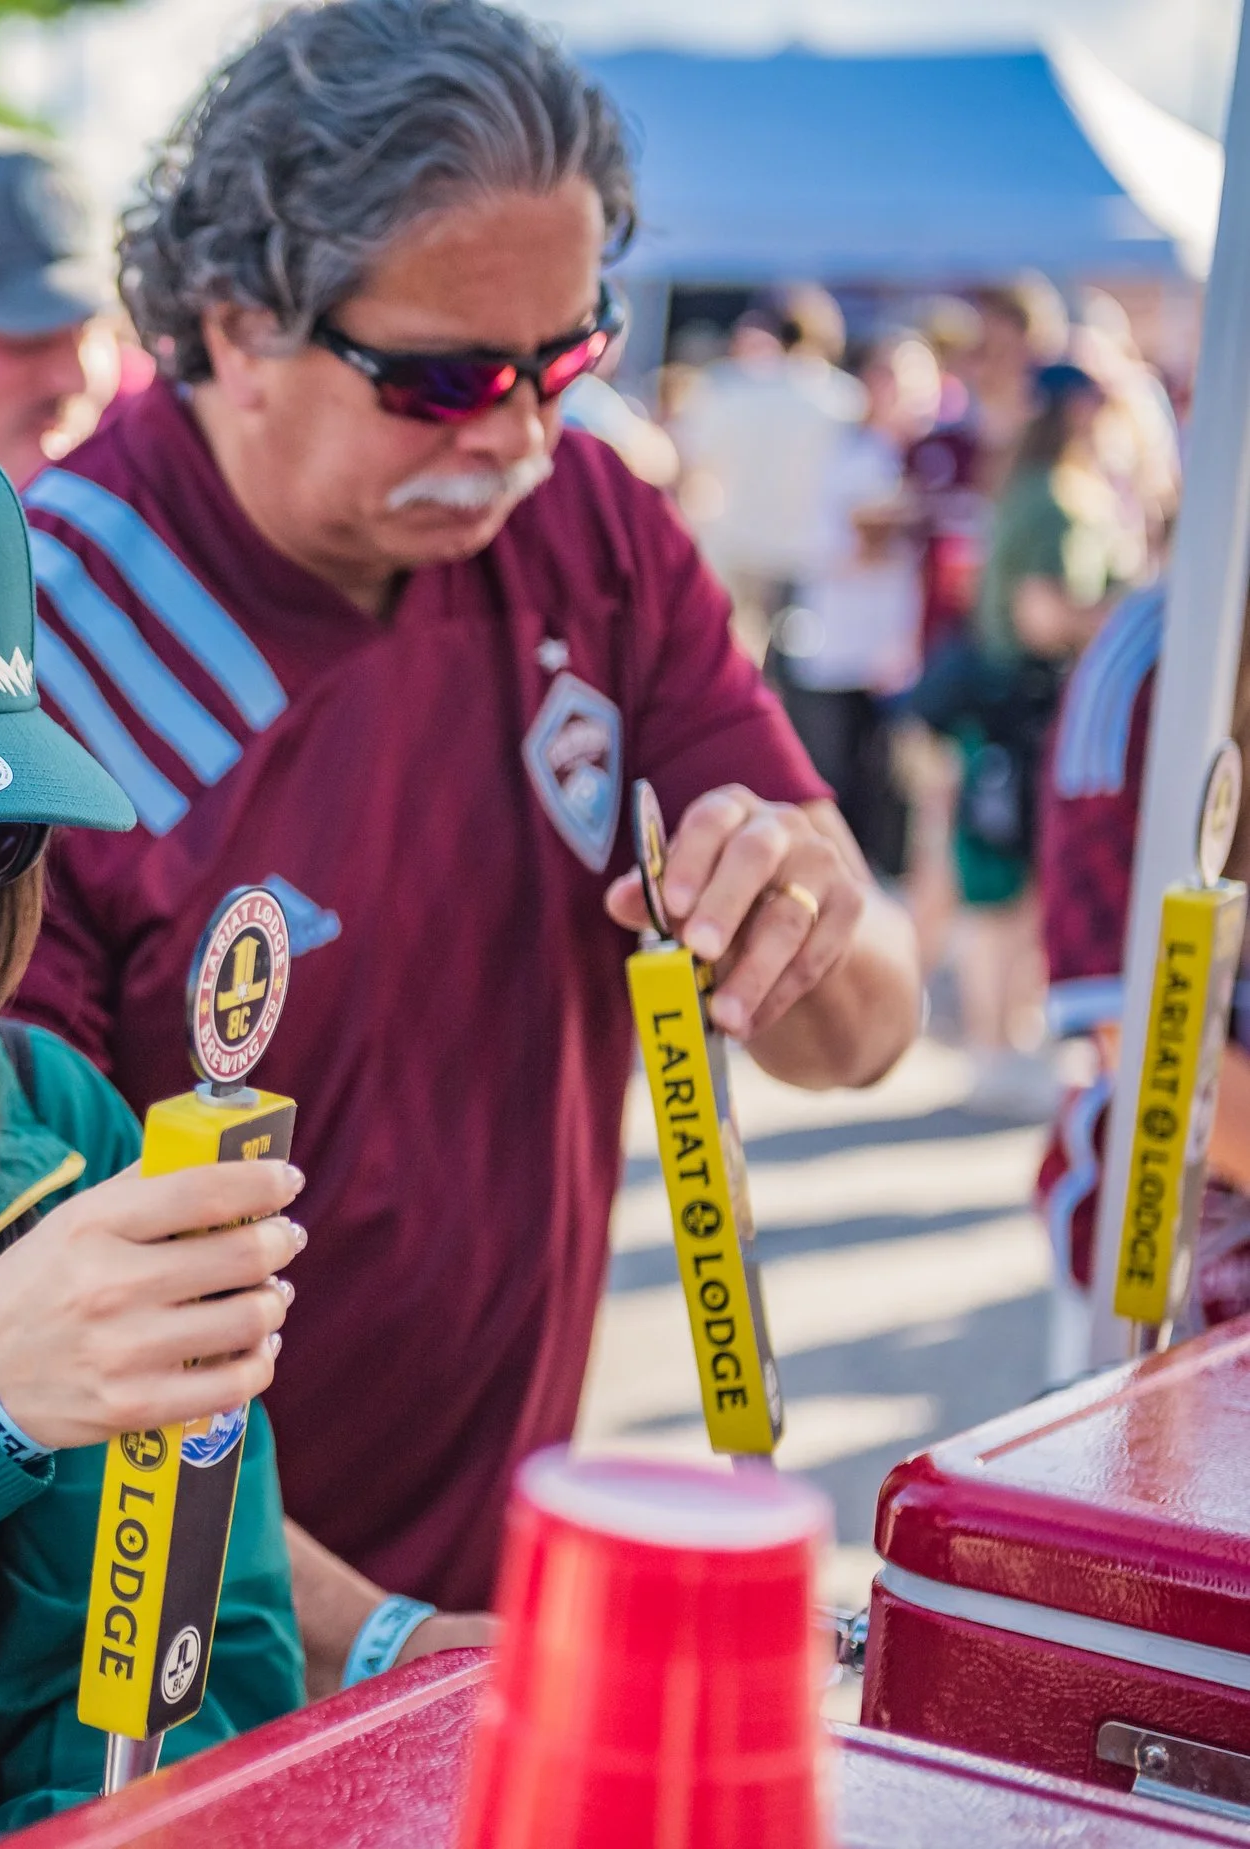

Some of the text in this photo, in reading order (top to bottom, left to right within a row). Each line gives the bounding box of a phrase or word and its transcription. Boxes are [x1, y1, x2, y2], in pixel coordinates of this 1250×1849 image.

[202, 900, 286, 990] LARIAT LODGE
[1152, 939, 1196, 1100] LARIAT
[200, 1022, 260, 1074] BREWING
[652, 1008, 749, 1413] LARIAT LODGE
[98, 1482, 156, 1681] LODGE
